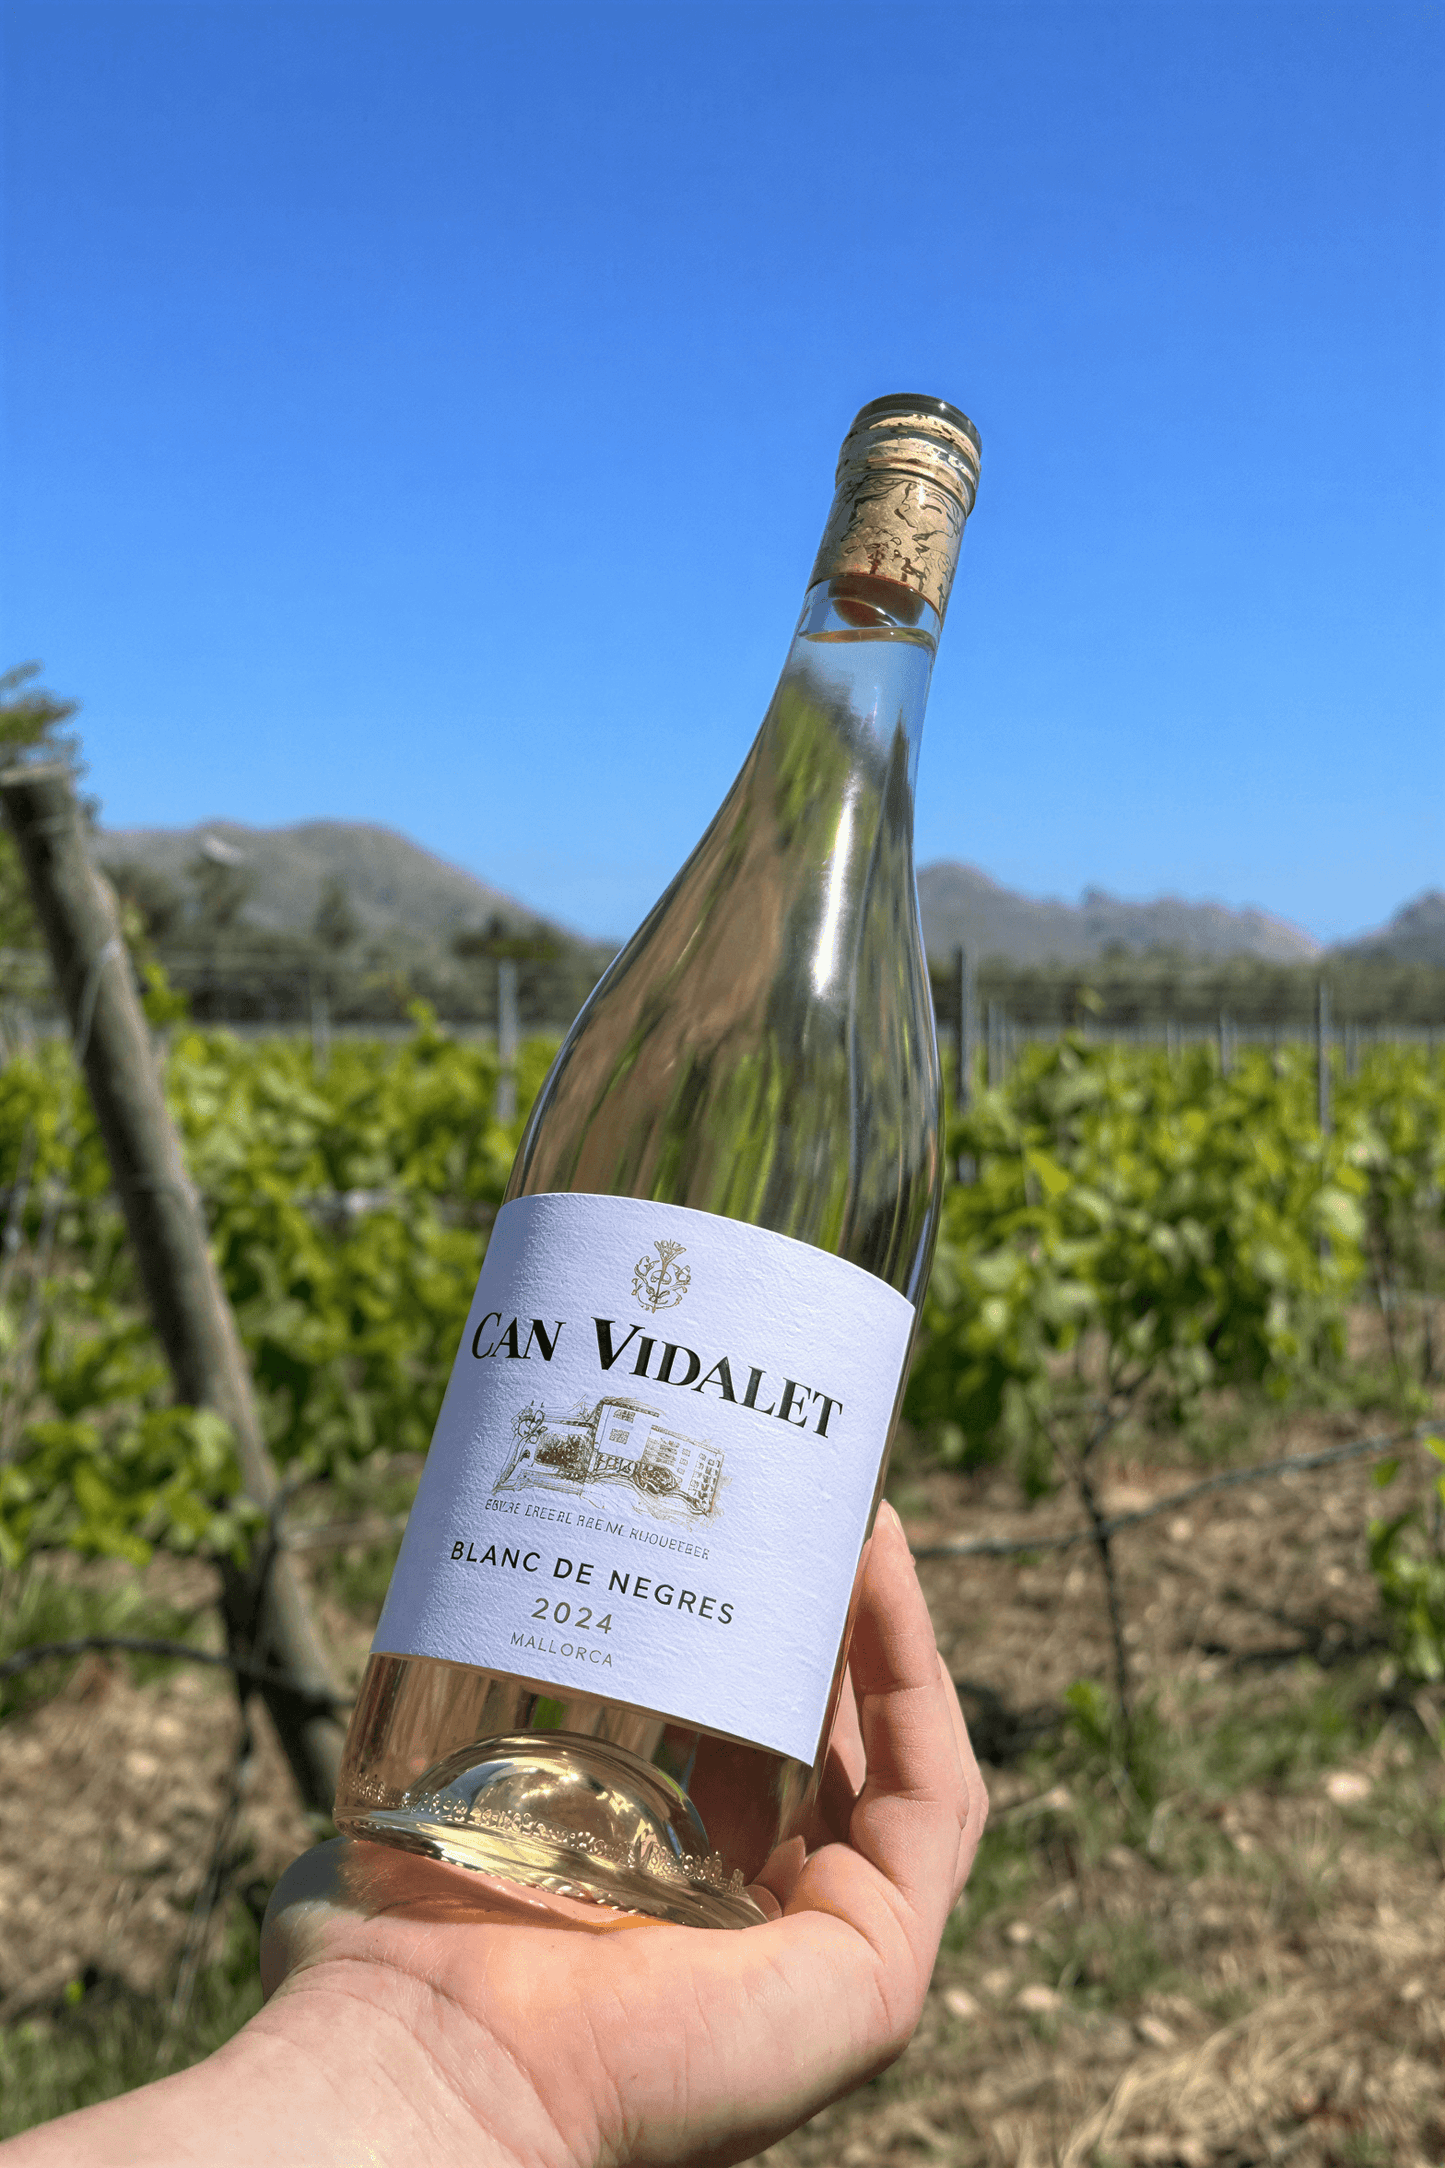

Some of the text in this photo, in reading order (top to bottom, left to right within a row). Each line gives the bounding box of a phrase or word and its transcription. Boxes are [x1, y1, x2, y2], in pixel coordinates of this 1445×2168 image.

[471, 1311, 843, 1438] CAN VIDALET
[450, 1541, 735, 1625] BLANC DE NEGRES
[531, 1597, 613, 1634] 2024
[510, 1631, 613, 1668] MALLORCA
